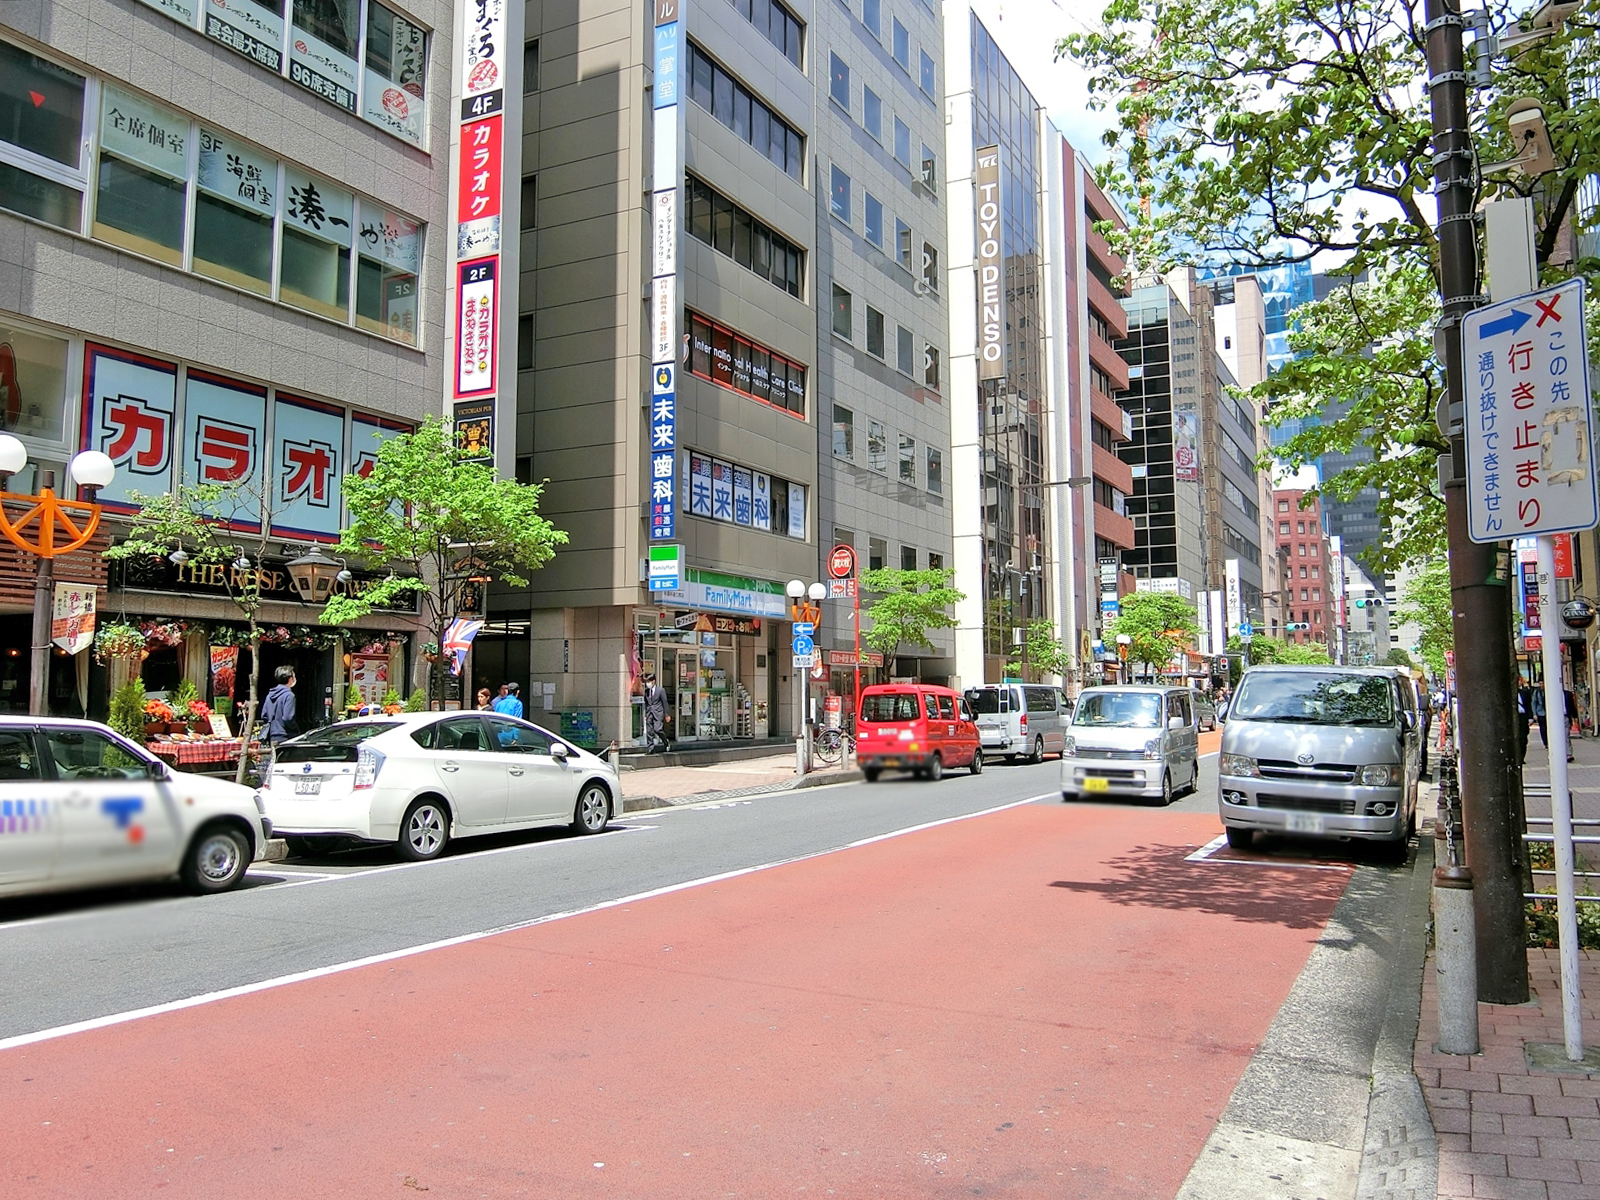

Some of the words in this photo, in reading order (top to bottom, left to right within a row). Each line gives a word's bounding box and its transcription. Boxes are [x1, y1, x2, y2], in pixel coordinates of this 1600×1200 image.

[208, 17, 280, 70] 宴会最大席数
[471, 96, 494, 116] 4F
[108, 107, 184, 157] 全席個室
[201, 133, 224, 154] 3F
[238, 182, 273, 207] 個室
[471, 125, 491, 216] カラオケ
[979, 183, 998, 258] TOYO
[470, 267, 487, 281] 2F
[464, 298, 476, 375] まねきねこ
[479, 307, 490, 361] カラオケ
[982, 265, 1002, 362] DENSO
[659, 343, 669, 353] 3F
[1549, 331, 1570, 403] この先
[482, 404, 492, 413] PUB
[788, 380, 804, 396] Clinic
[653, 398, 674, 503] 未来歯科
[1478, 352, 1503, 532] 通り抜けできません
[1508, 340, 1541, 528] 行き止まり
[693, 481, 769, 528] 未来歯科
[173, 562, 224, 586] THE
[705, 586, 752, 608] FamilyMart
[797, 641, 806, 654] P
